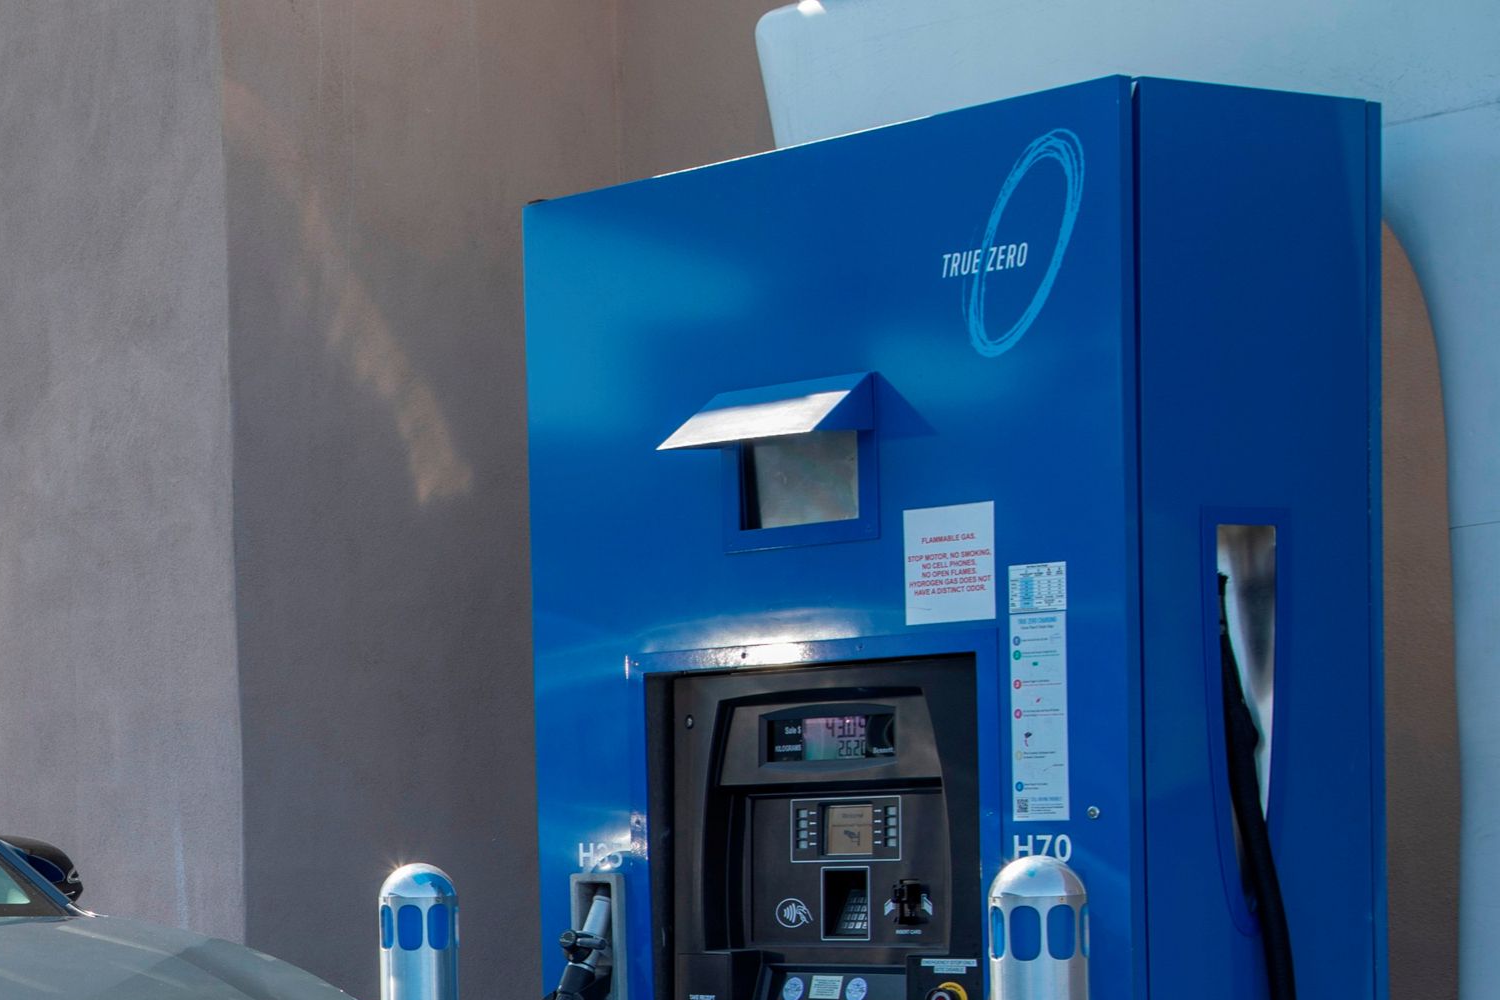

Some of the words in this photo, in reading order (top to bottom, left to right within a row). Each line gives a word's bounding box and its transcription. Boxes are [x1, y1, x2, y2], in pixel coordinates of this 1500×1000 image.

[942, 249, 982, 278] TRUE
[986, 243, 1028, 272] ZERO
[921, 534, 959, 544] FLAMMABLE
[932, 561, 948, 569] CELL
[909, 579, 943, 588] HYDROGEN
[960, 576, 976, 584] DOES
[937, 586, 965, 594] DISTINCT
[784, 726, 797, 735] Sale
[1013, 834, 1072, 863] H70
